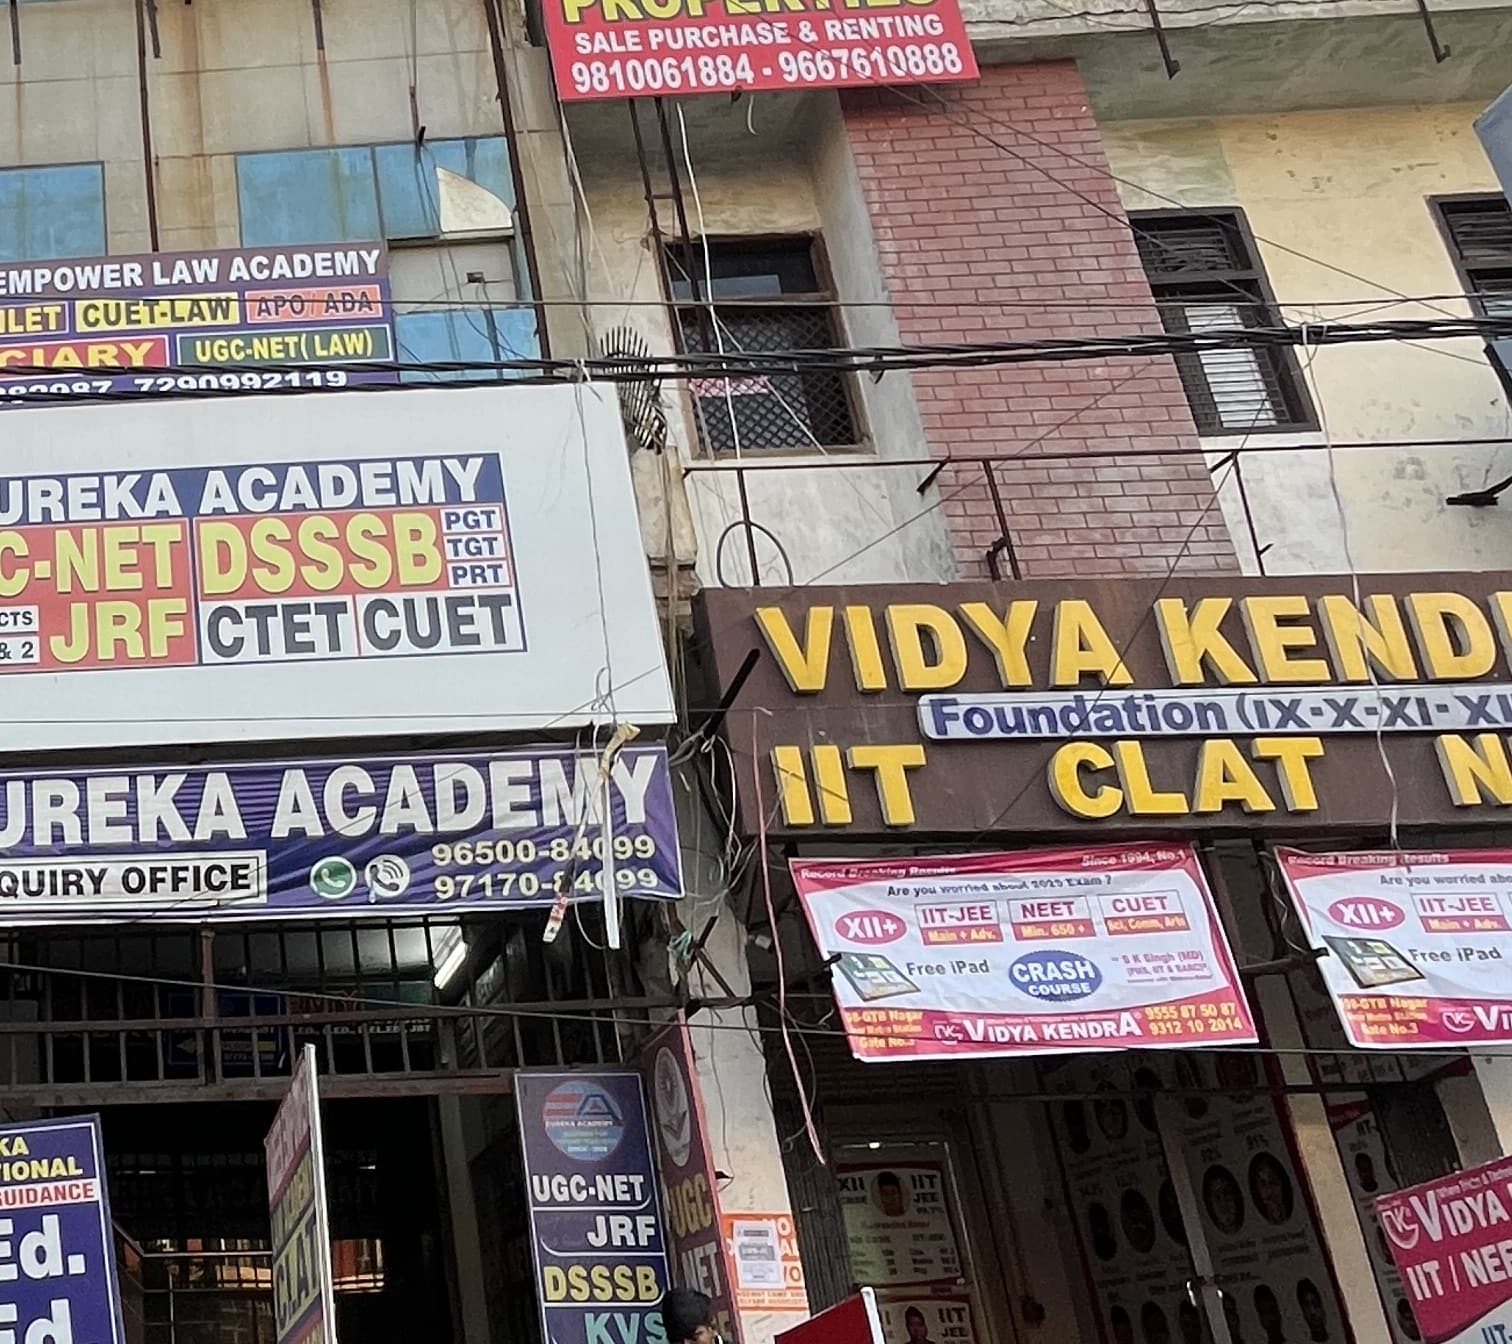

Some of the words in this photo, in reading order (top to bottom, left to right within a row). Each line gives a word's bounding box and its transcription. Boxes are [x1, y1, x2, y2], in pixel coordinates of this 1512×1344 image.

[575, 28, 640, 54] SALE
[650, 22, 792, 49] PURCHASE
[826, 14, 944, 42] RENTING
[571, 56, 755, 93] 9810061884
[782, 46, 963, 83] 9667610888
[153, 259, 218, 287] LAW
[229, 249, 380, 281] ACADEMY
[81, 297, 230, 328] CUET-LAW
[256, 293, 305, 318] APO
[323, 287, 374, 315] ADA
[198, 456, 484, 515] ACADEMY
[444, 509, 497, 532] PGT
[200, 512, 444, 596] DSSSB
[447, 535, 499, 557] TGT
[451, 564, 504, 586] PRT
[49, 598, 187, 664] JRF
[206, 602, 349, 657] CTET
[361, 593, 512, 651] CUET
[20, 641, 34, 661] 2
[756, 598, 1133, 694] VIDYA
[930, 692, 1226, 739] Foundation
[770, 743, 927, 826] IIT
[1048, 736, 1325, 819] CLAT
[272, 756, 658, 839] ACADEMY
[120, 862, 251, 895] OFFICE
[1380, 875, 1403, 884] Are
[1407, 875, 1430, 887] you
[1434, 875, 1485, 884] worried
[913, 885, 937, 899] you
[922, 905, 993, 925] IIT-JEE
[1020, 901, 1075, 919] NEET
[1112, 896, 1168, 914] CUET
[1337, 904, 1395, 924] XII+
[1419, 897, 1496, 912] IIT-JEE
[844, 917, 897, 938] XII+
[927, 930, 957, 943] Main
[1020, 926, 1049, 938] Min.
[1052, 923, 1075, 936] 650
[1409, 948, 1453, 962] Free
[1458, 947, 1502, 961] iPad
[906, 961, 945, 977] Free
[950, 959, 990, 975] iPad
[1012, 960, 1096, 983] CRASH
[1028, 982, 1091, 996] COURSE
[1145, 1006, 1178, 1020] 9555
[964, 1019, 1038, 1044] VIDYA
[1043, 1012, 1143, 1041] KENDRA
[1149, 1021, 1183, 1035] 9312
[1188, 1020, 1204, 1033] 10
[1209, 1018, 1243, 1032] 2014
[532, 1173, 645, 1204] UGC-NET
[911, 1174, 938, 1190] IIT
[587, 1214, 657, 1249] JRF
[542, 1264, 660, 1304] DSSSB
[1406, 1260, 1444, 1300] IIT
[938, 1307, 966, 1323] IIT
